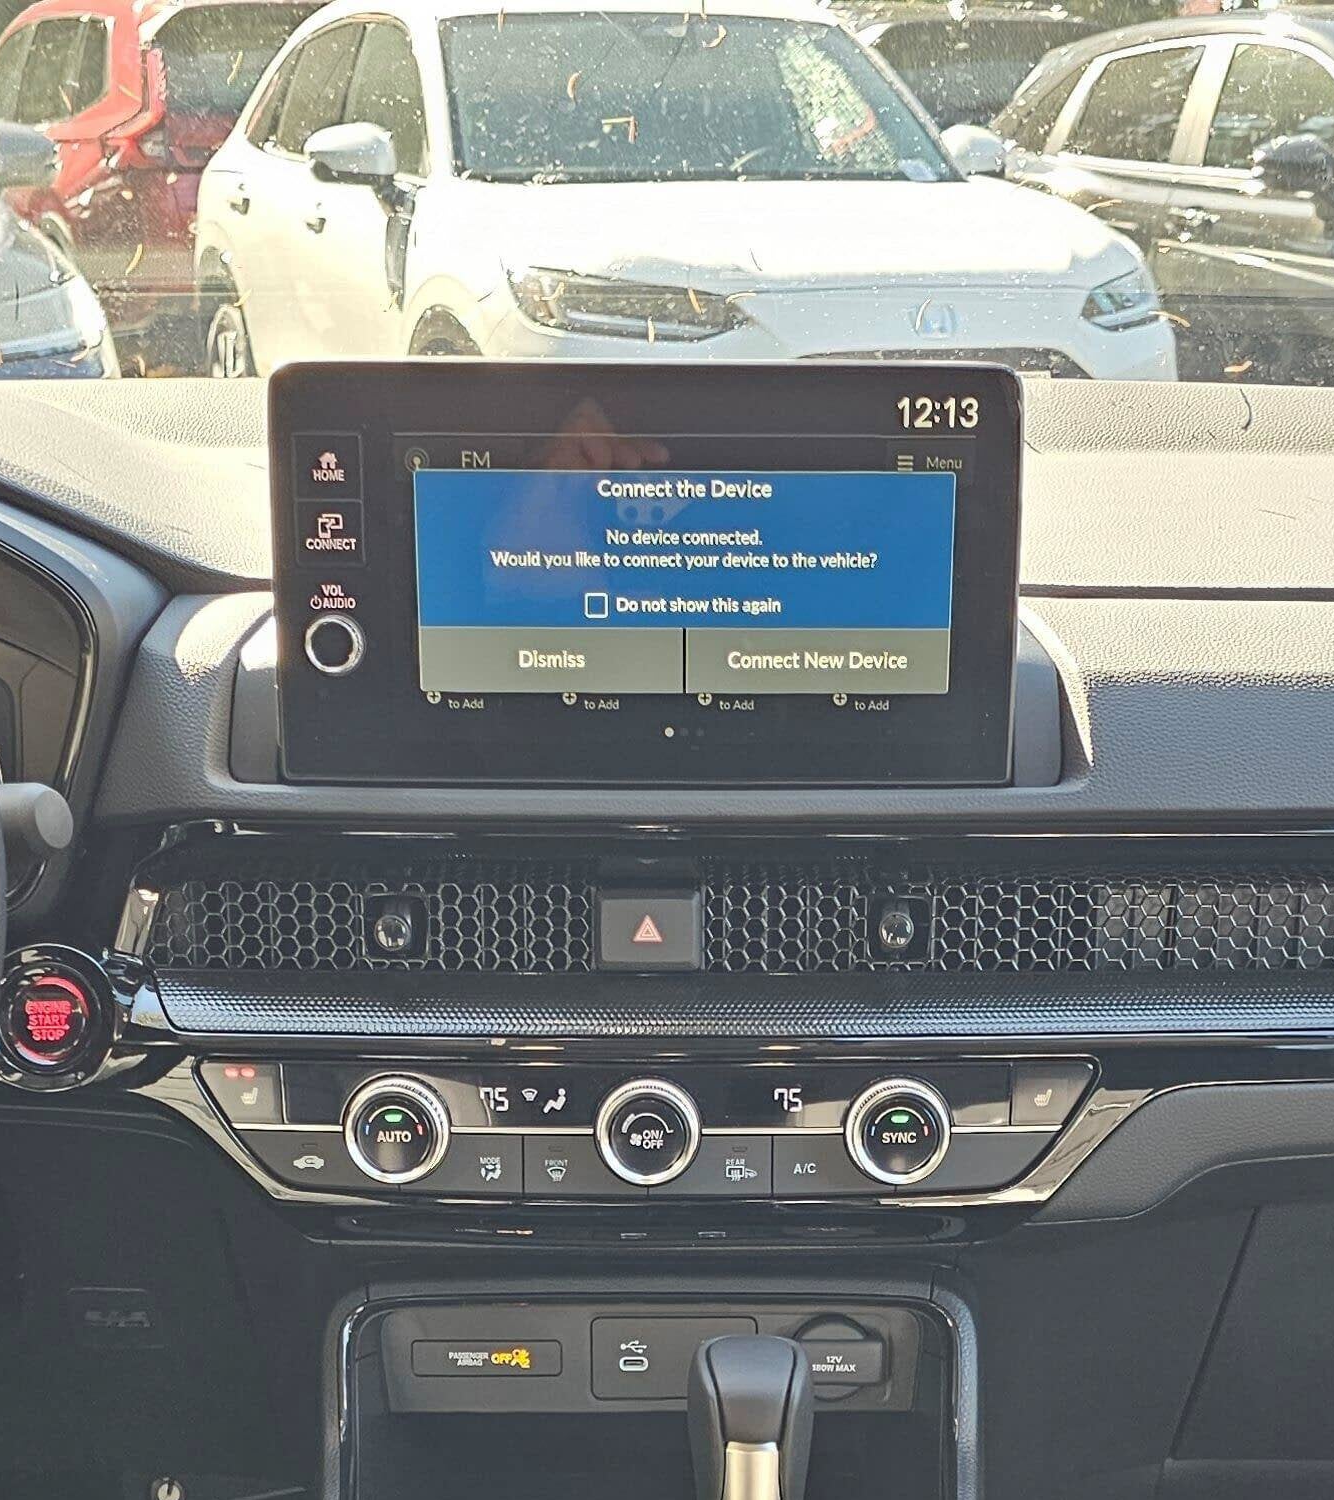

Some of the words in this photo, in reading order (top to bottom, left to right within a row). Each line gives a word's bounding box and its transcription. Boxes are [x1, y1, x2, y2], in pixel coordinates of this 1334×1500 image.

[896, 396, 980, 429] 12:13
[460, 451, 491, 469] FM
[926, 456, 963, 470] Menu
[313, 469, 346, 482] HOME
[597, 480, 673, 499] Connect
[676, 480, 706, 498] the
[711, 480, 773, 499] Device
[606, 529, 629, 546] No
[632, 528, 680, 546] device
[682, 529, 763, 547] connected.
[305, 538, 357, 551] CONNECT
[490, 551, 541, 569] Would
[543, 554, 573, 571] you
[575, 552, 601, 569] like
[603, 554, 620, 569] to
[623, 553, 682, 569] connect
[684, 555, 721, 572] your
[722, 552, 770, 569] device
[772, 554, 790, 569] to
[791, 552, 817, 569] the
[819, 552, 879, 570] vehicle?
[321, 584, 345, 597] VOL
[322, 597, 357, 610] AUDIO
[616, 597, 639, 613] Do
[641, 598, 667, 614] not
[670, 597, 710, 614] show
[712, 597, 740, 614] this
[741, 598, 782, 617] again
[518, 649, 586, 670] Dismiss
[727, 650, 800, 671] Connect
[803, 650, 845, 671] New
[848, 649, 908, 671] Device
[448, 698, 459, 710] to
[460, 698, 484, 710] Add
[584, 698, 595, 710] to
[596, 698, 620, 710] Add
[719, 699, 730, 711] to
[731, 699, 755, 711] Add
[854, 699, 865, 711] to
[866, 699, 890, 711] Add
[25, 1000, 72, 1014] ENGINE
[28, 1015, 68, 1026] START
[31, 1029, 65, 1041] STOP
[478, 1087, 509, 1112] 75
[774, 1088, 803, 1113] 75
[376, 1130, 412, 1143] AUTO
[642, 1129, 664, 1140] ON/
[881, 1131, 917, 1144] SYNC
[642, 1139, 664, 1150] OFF
[479, 1157, 501, 1165] MODE
[544, 1159, 569, 1167] FRONT
[725, 1158, 746, 1166] REAR
[793, 1163, 817, 1175] A/C
[491, 1352, 513, 1365] OFF
[826, 1355, 843, 1364] 12V
[835, 1363, 857, 1373] MAX
